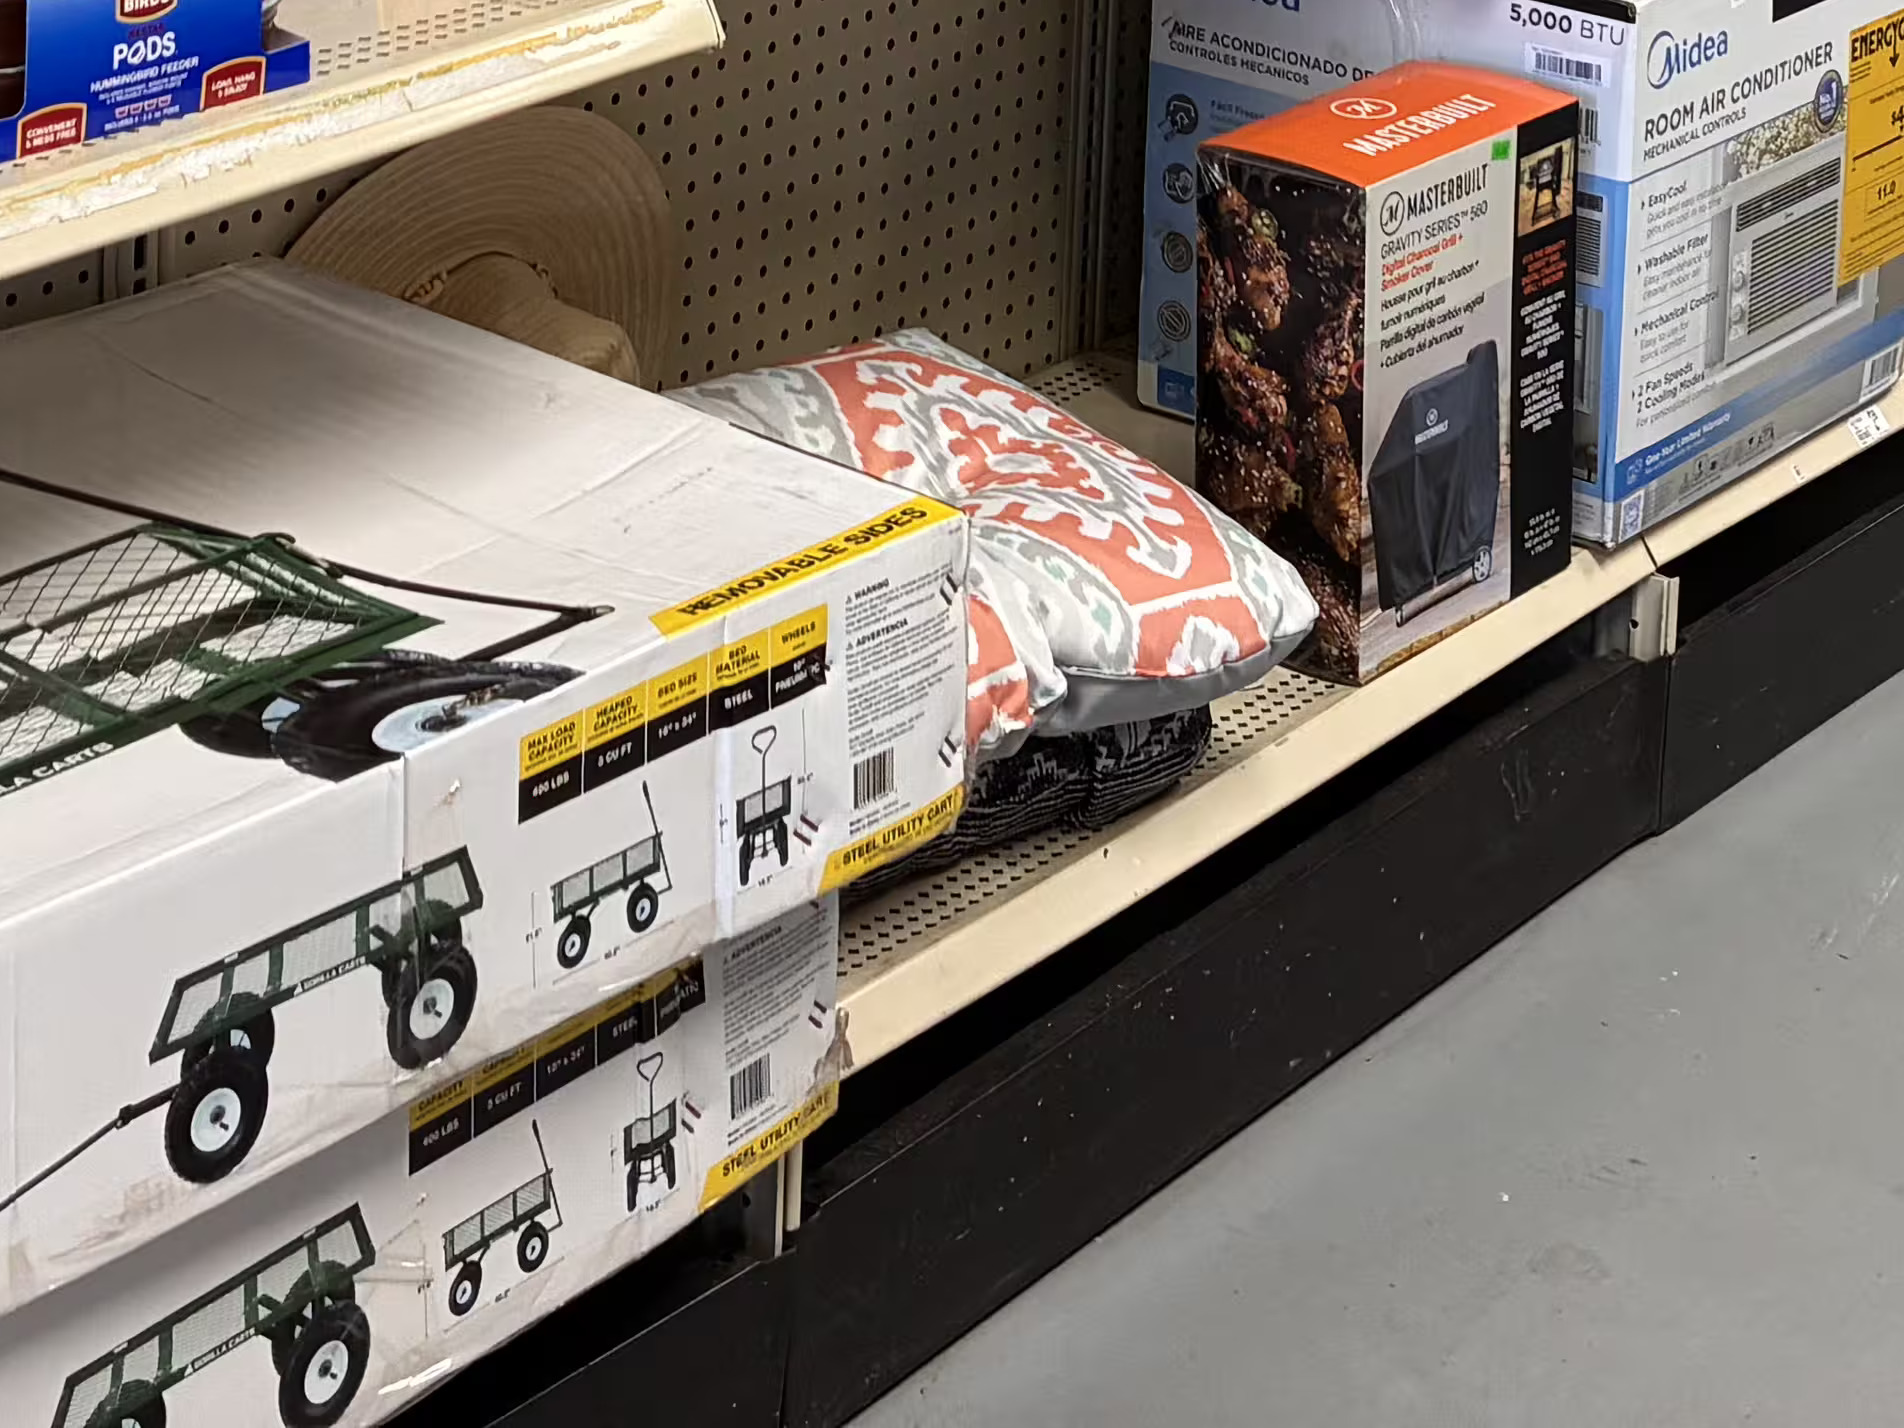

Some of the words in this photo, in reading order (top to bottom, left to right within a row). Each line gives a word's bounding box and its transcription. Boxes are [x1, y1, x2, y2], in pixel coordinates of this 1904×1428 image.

[1508, 1, 1574, 34] 5,000
[1579, 19, 1626, 46] BTU
[112, 31, 177, 71] PODS
[1168, 40, 1239, 66] CONTROLES
[1239, 56, 1311, 87] MECANICOS
[1209, 30, 1349, 80] ACONDICIONADO
[1646, 29, 1729, 90] Midea
[1643, 104, 1694, 143] ROOM
[1698, 88, 1727, 118] AIR
[1730, 40, 1834, 106] CONDITIONER
[1342, 93, 1497, 158] MASTERBUILT
[1642, 121, 1701, 162] MECHANICAL
[1701, 106, 1748, 137] CONTROLS
[1406, 162, 1489, 222] MASTERBUILT
[1876, 179, 1897, 201] 11.0
[1380, 224, 1423, 260] GRAVITY
[1639, 306, 1688, 335] Mechanical
[676, 536, 848, 619] REMOVABLE
[842, 505, 929, 546] SIDES
[714, 649, 762, 674] MATERIAL
[32, 741, 115, 780] CARTS
[527, 733, 576, 762] CAPACITY
[882, 815, 925, 848] UTILITY
